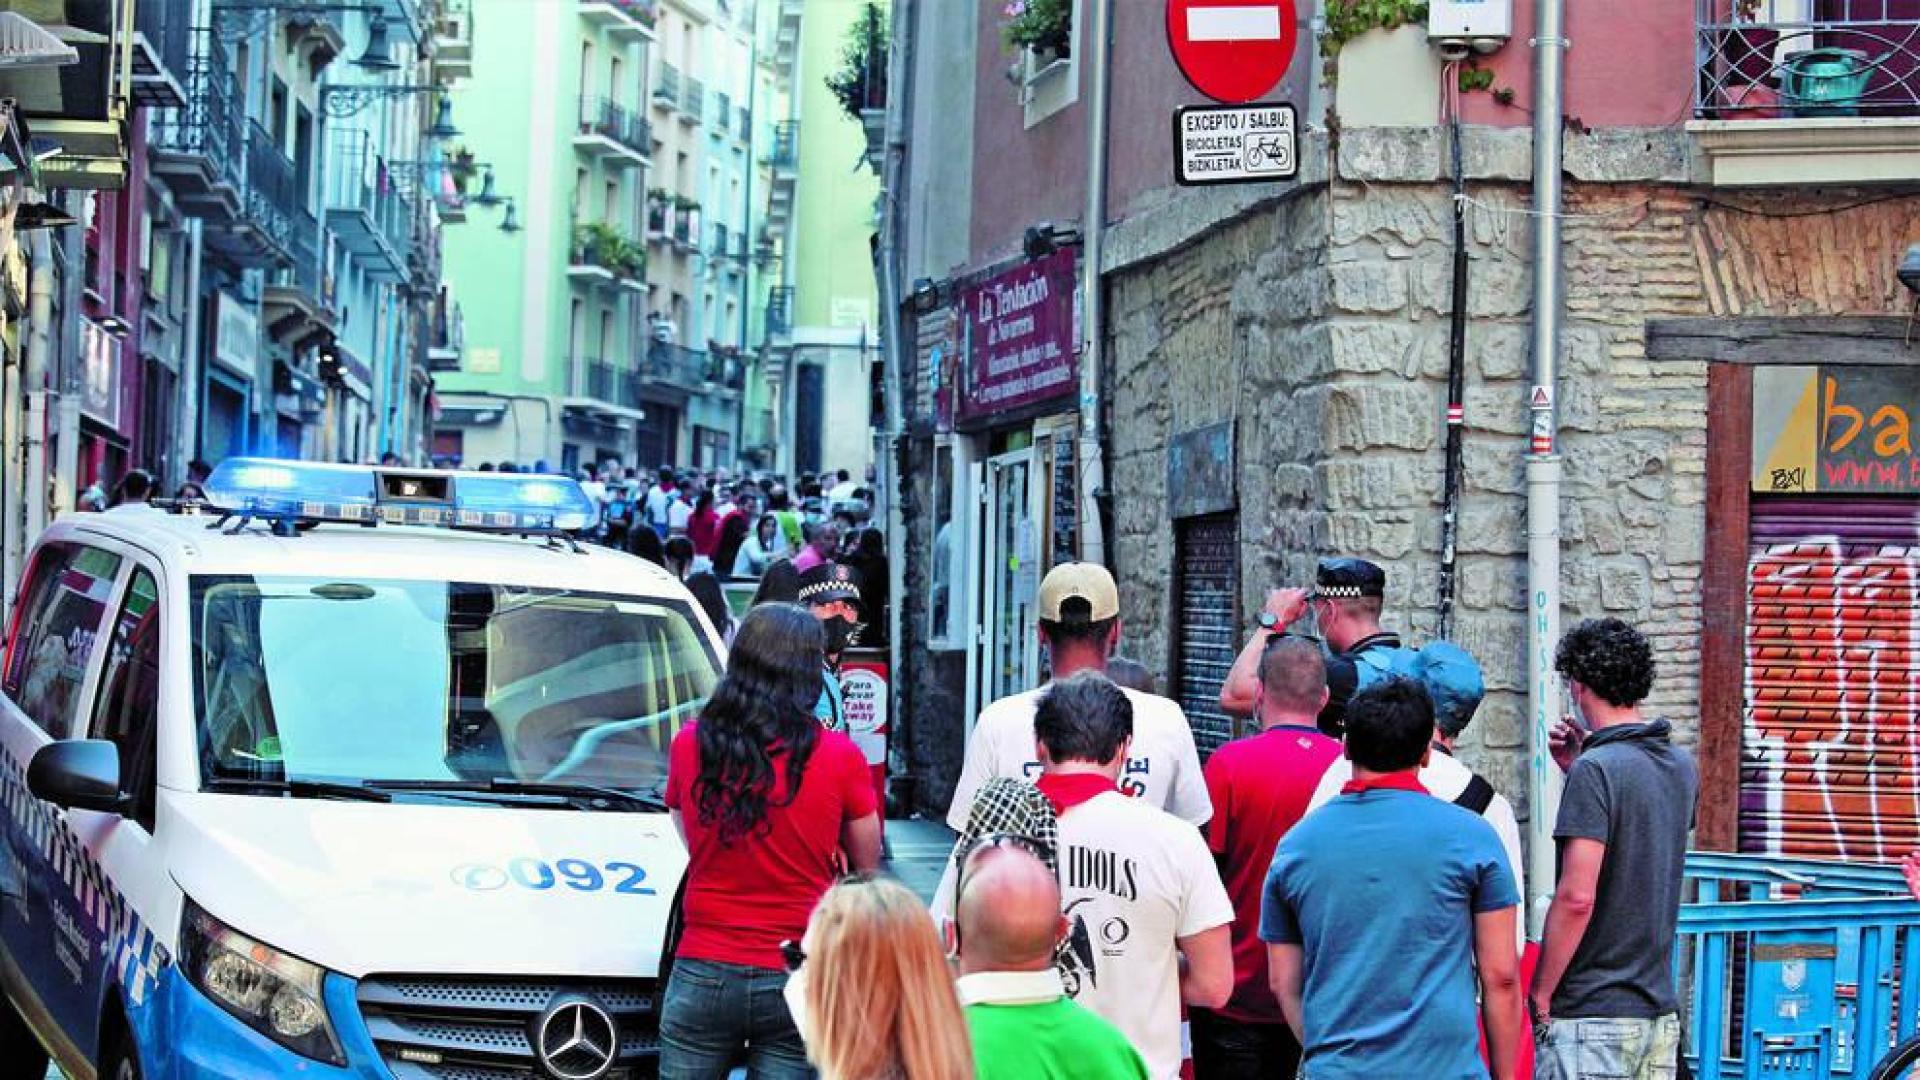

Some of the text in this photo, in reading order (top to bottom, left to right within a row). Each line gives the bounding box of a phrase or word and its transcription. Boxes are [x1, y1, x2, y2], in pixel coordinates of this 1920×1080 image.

[1187, 111, 1288, 131] EXCEPTO / SALBU:
[1186, 135, 1242, 151] BICICLETAS
[1188, 158, 1242, 173] BIZIKLETAK
[978, 289, 994, 323] La
[844, 701, 874, 711] Take
[508, 856, 657, 896] 092
[1068, 845, 1138, 901] IDOLS
